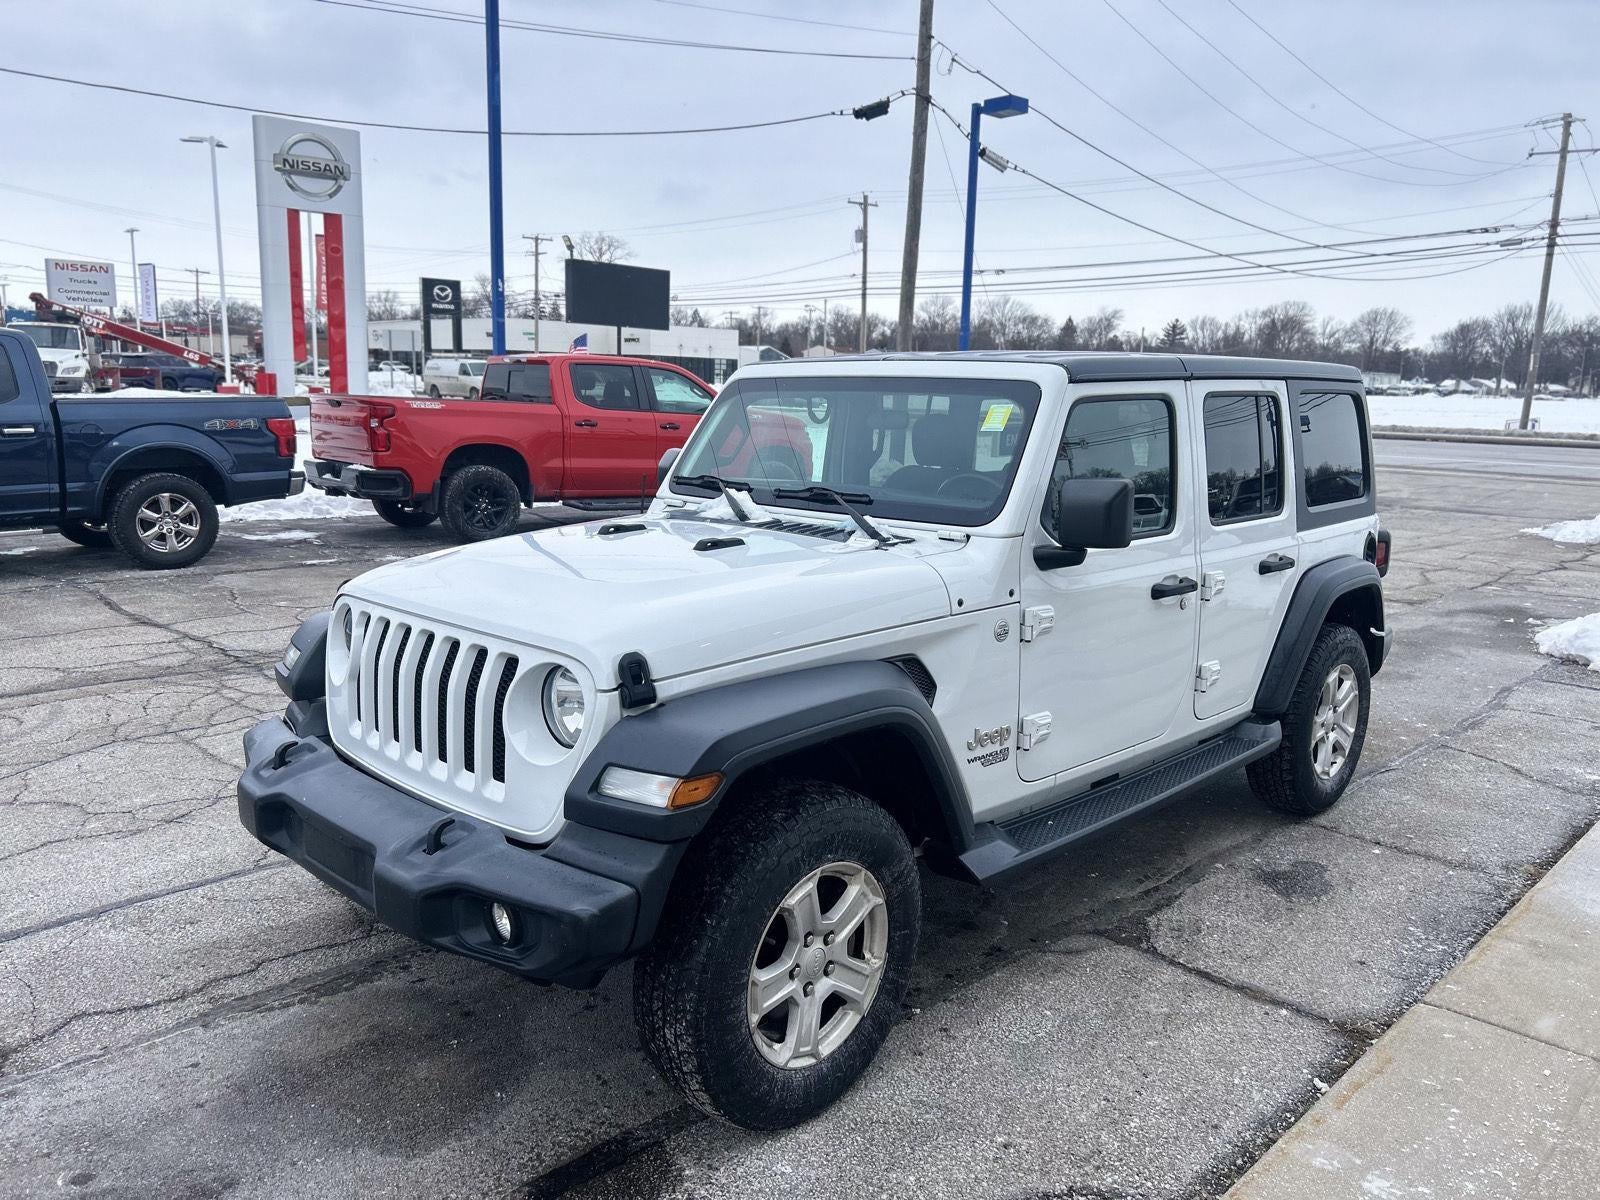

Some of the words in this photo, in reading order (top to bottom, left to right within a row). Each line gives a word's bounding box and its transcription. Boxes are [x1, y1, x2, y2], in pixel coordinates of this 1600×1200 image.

[282, 158, 345, 177] NISSAN
[54, 262, 109, 274] NISSAN
[68, 277, 98, 285] Trucks
[57, 287, 110, 296] Commercial
[65, 295, 104, 303] Vehicles
[967, 724, 1012, 751] Jeep
[966, 746, 1010, 764] WRANGLER
